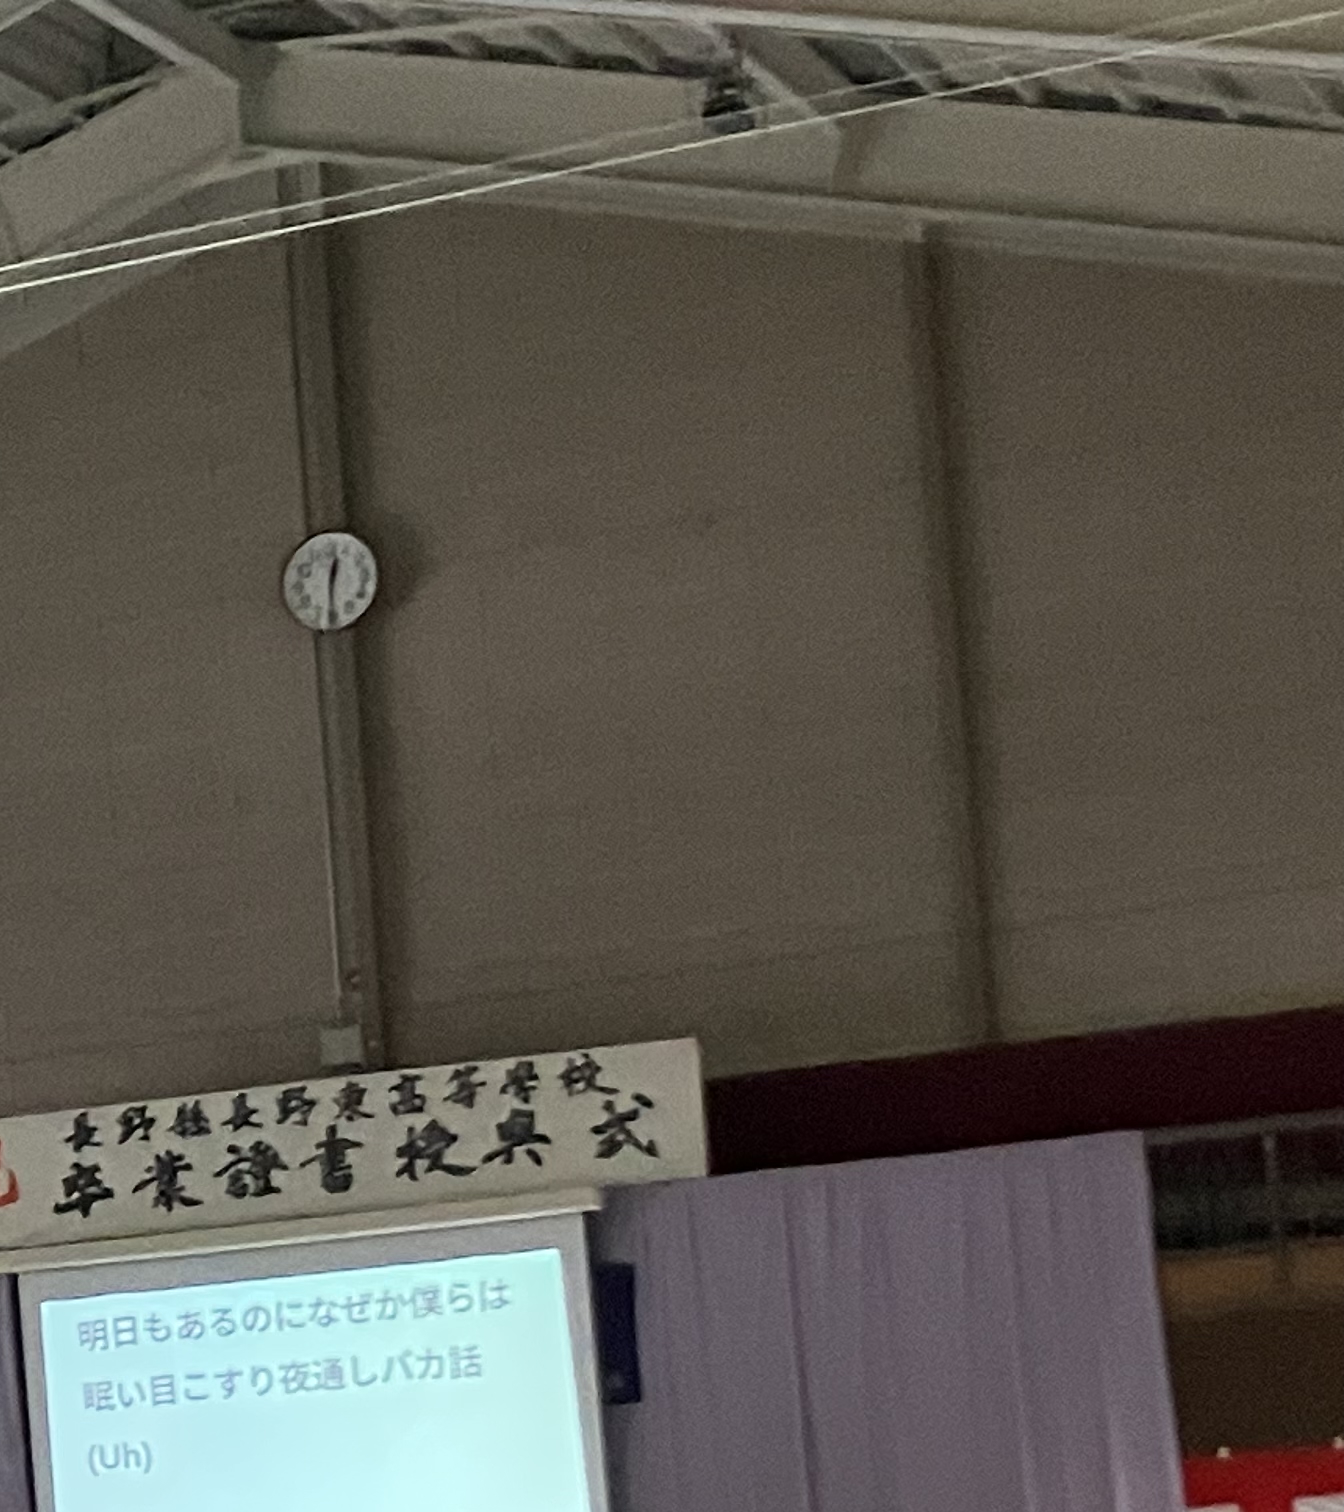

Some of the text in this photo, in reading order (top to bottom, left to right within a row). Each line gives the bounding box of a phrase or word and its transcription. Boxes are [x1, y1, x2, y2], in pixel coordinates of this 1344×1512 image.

[77, 1278, 513, 1352] 明日もあるのになぜか僕らは
[82, 1344, 484, 1412] 眠い目こすり夜通しバカ話
[87, 1440, 153, 1477] (Uh)
